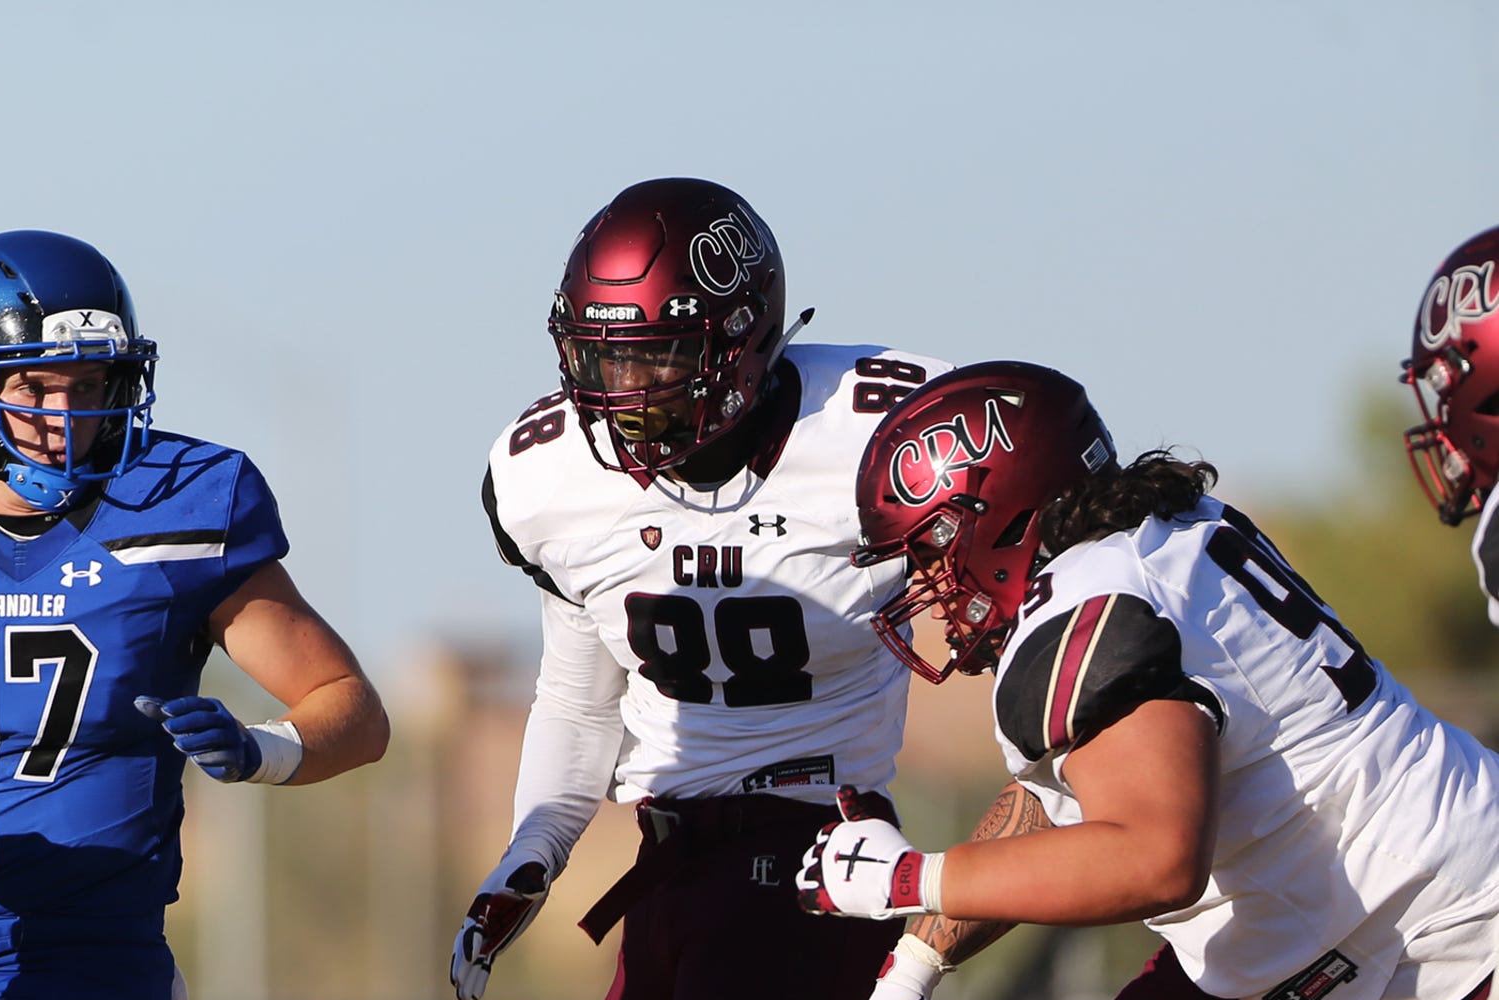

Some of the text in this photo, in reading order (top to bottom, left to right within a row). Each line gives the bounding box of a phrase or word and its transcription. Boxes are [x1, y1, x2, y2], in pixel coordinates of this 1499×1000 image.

[585, 305, 636, 320] Riddell
[889, 398, 1015, 508] CRU
[672, 545, 744, 589] CRU
[624, 591, 814, 708] 88
[900, 863, 913, 896] CRU
